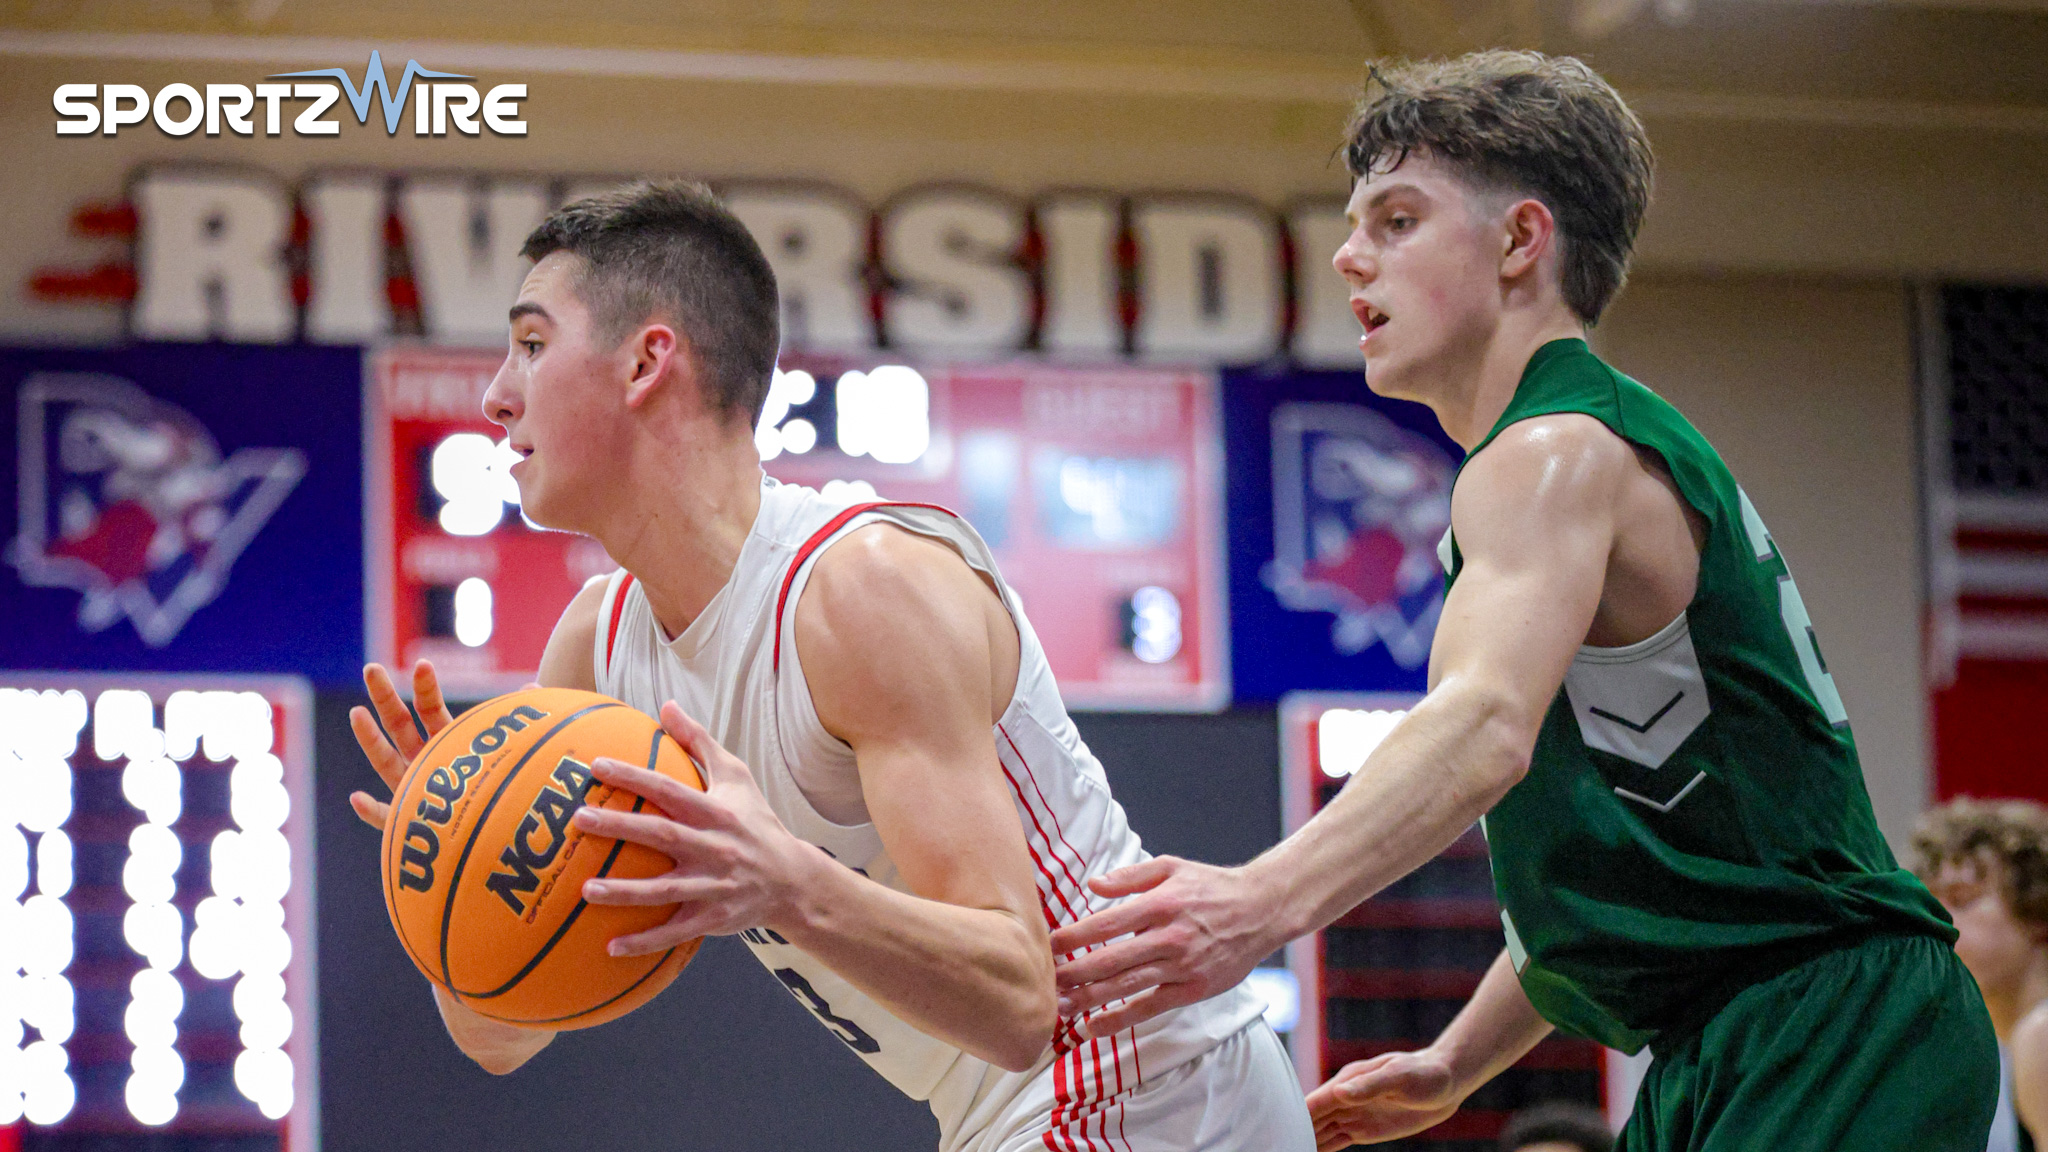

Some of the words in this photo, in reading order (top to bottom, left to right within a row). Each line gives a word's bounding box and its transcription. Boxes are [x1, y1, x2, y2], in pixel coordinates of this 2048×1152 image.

[134, 168, 1364, 368] RIVRSID
[399, 704, 551, 894] Wilson
[485, 755, 603, 917] NCAA
[526, 862, 567, 925] OFFICIAL
[564, 831, 586, 861] GAM
[774, 967, 881, 1054] 3
